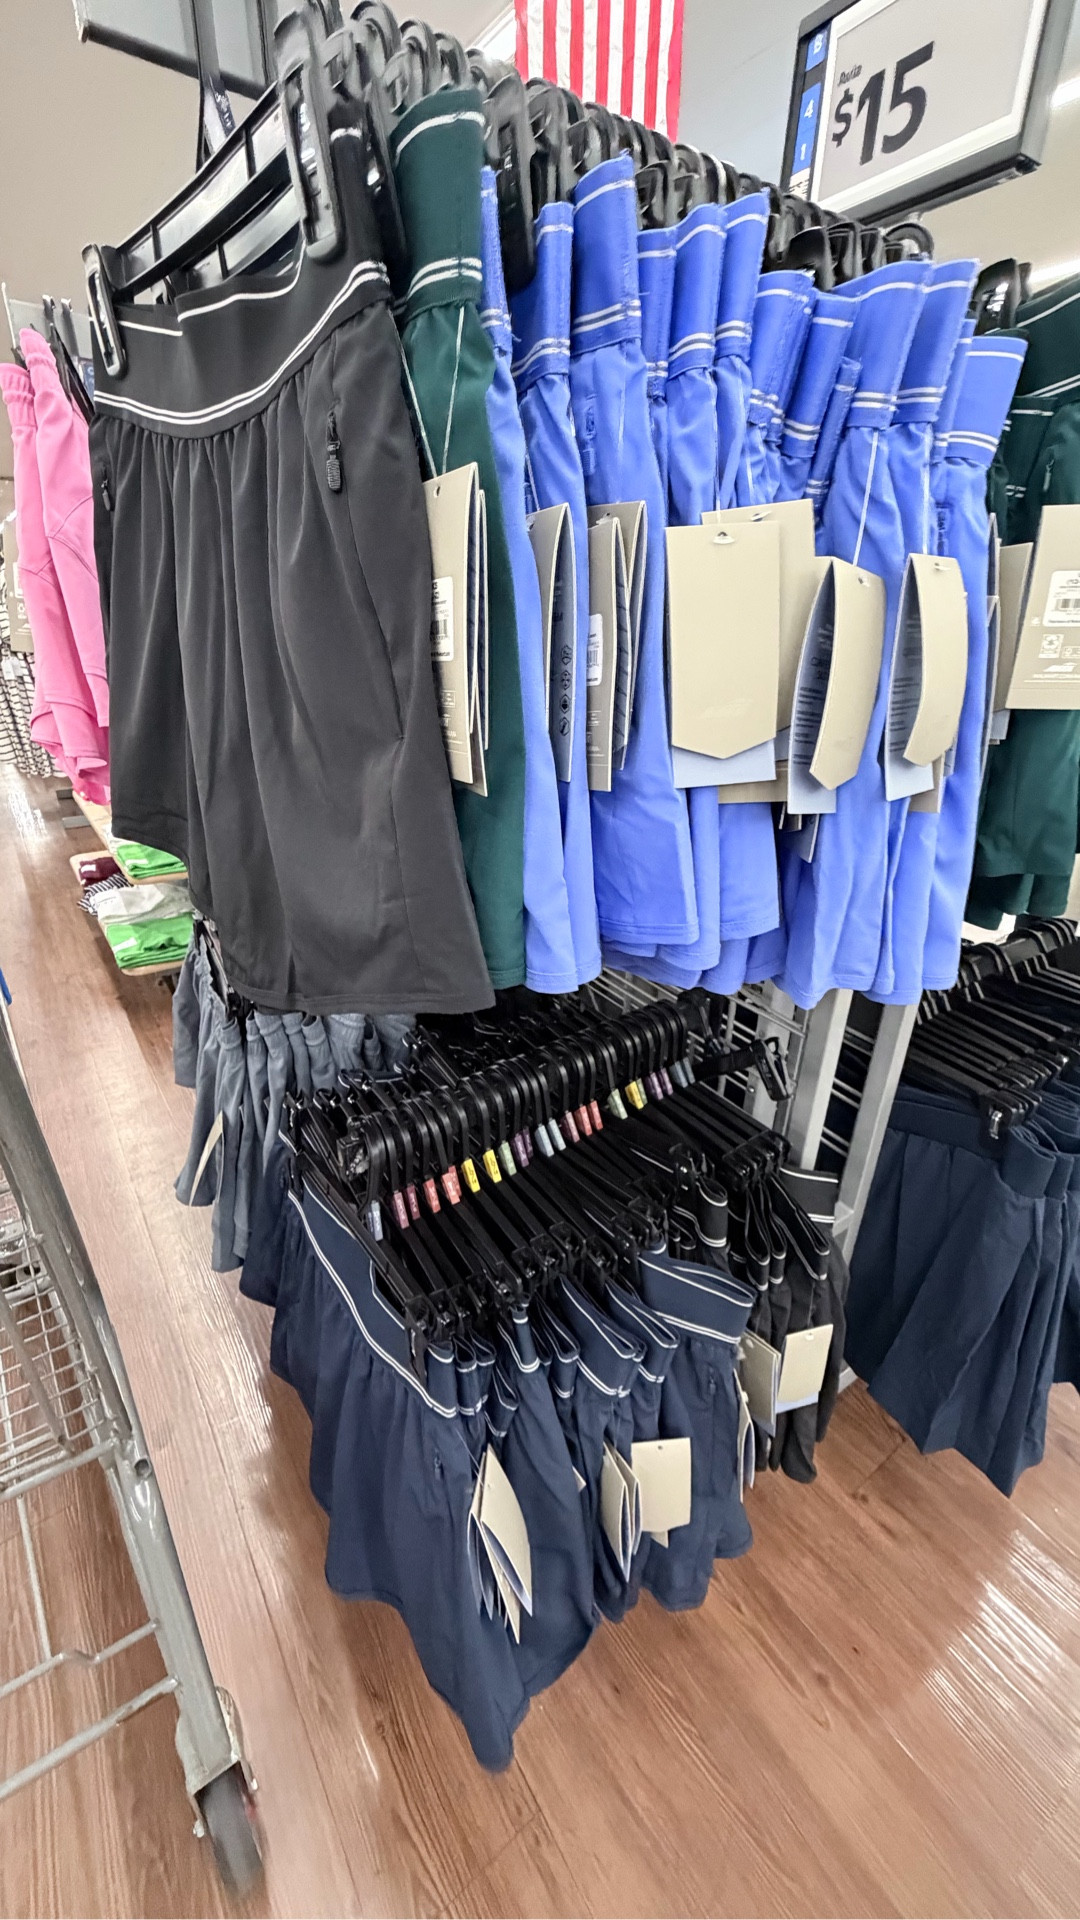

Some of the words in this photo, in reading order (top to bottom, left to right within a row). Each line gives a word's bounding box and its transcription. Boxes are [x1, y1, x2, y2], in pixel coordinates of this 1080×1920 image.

[813, 33, 824, 55] B
[804, 99, 815, 118] 4
[831, 40, 935, 166] $15
